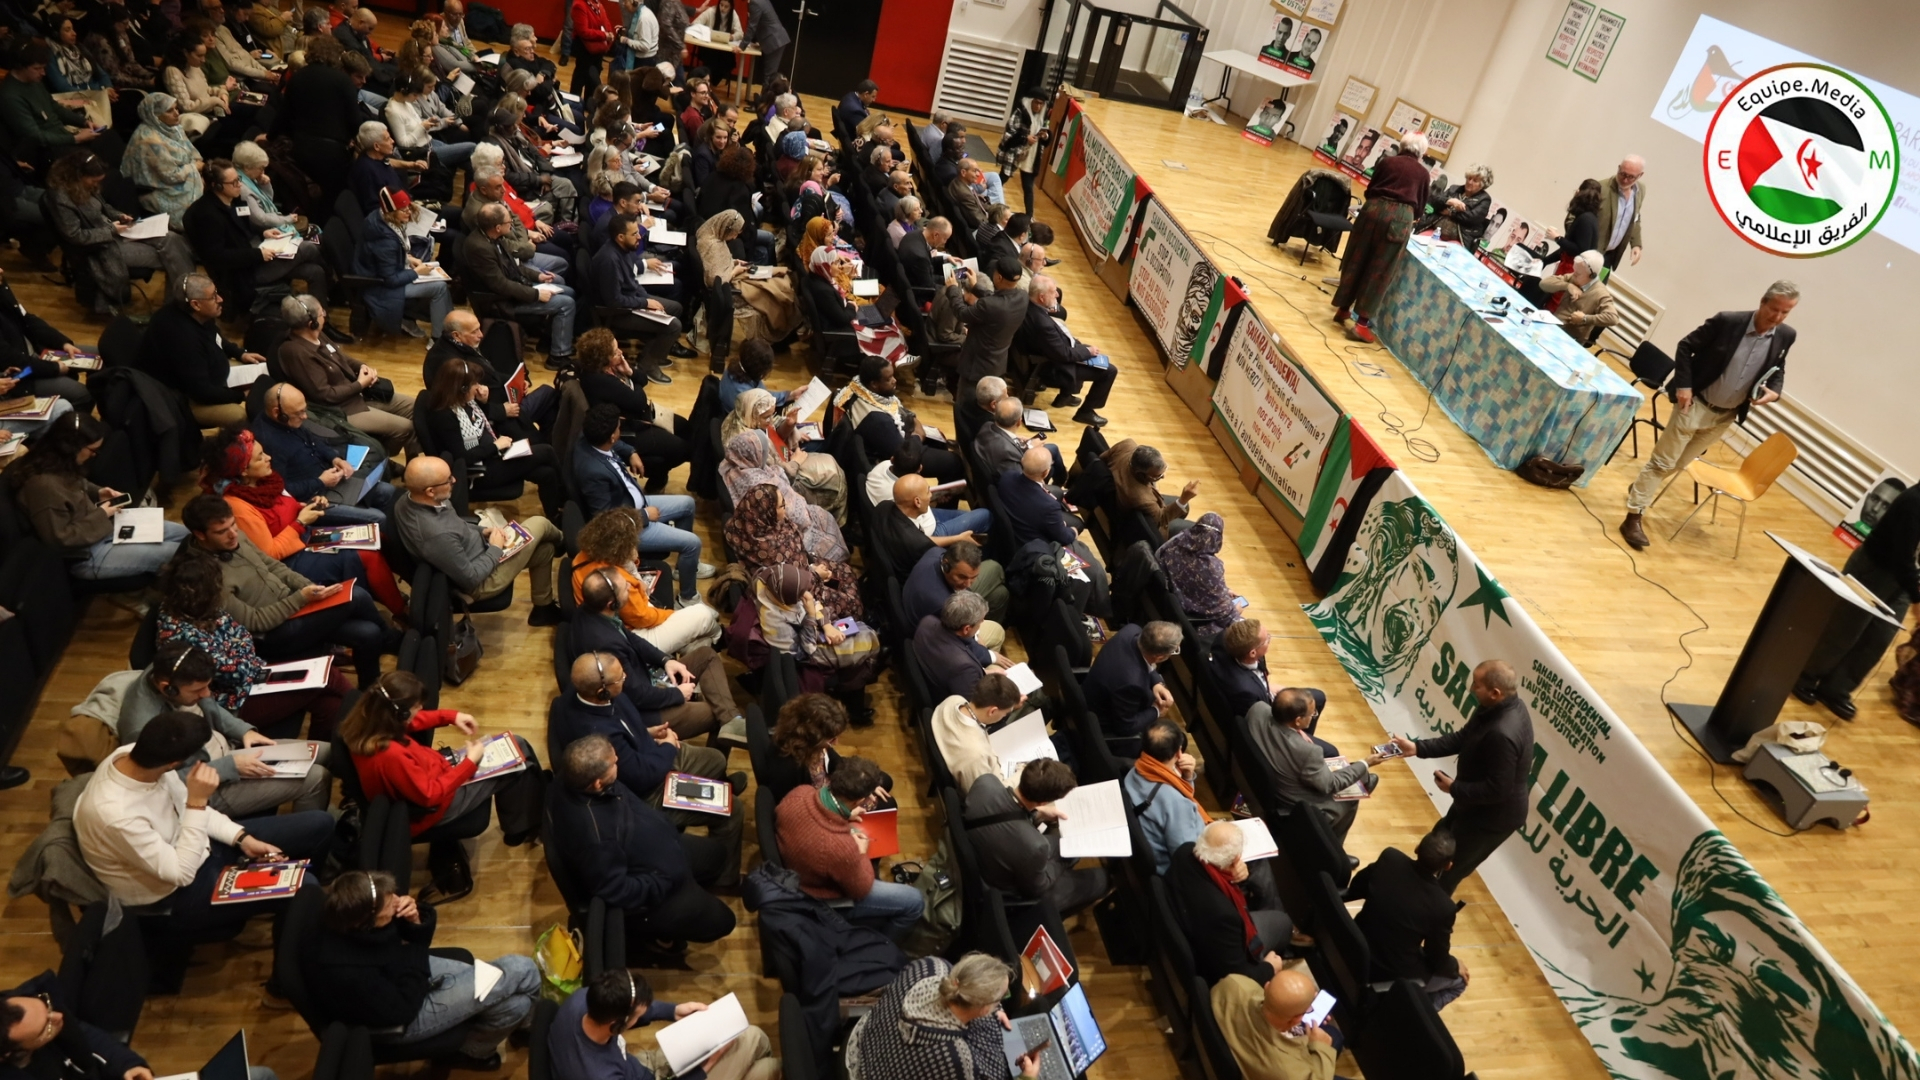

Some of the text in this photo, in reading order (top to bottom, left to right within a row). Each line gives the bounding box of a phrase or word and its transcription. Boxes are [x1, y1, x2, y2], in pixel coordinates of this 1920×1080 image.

[1429, 129, 1449, 141] LIBRE
[1431, 118, 1454, 134] SAHARA
[1151, 212, 1190, 267] SAHARA OCCIDENTAL
[1158, 243, 1169, 262] STOP
[1136, 281, 1146, 298] NOS
[1138, 265, 1150, 283] STOP
[1148, 277, 1155, 292] AU
[1236, 352, 1246, 369] NON
[1244, 364, 1261, 388] MERCI
[1246, 320, 1300, 395] SAHARA OCCIDENTAL
[1264, 370, 1285, 402] marocain
[1265, 390, 1278, 412] Notre
[1222, 396, 1234, 422] Place
[1256, 406, 1268, 422] nos
[1260, 433, 1273, 449] voix
[1532, 659, 1563, 689] SAHARA
[1521, 675, 1606, 764] L'AUTODETERMINATION
[1536, 675, 1598, 739] UNE LUTTE POUR
[1531, 697, 1539, 710] &
[1540, 704, 1550, 719] LA
[1549, 715, 1580, 749] JUSTICE
[1536, 768, 1661, 912] LIBRE
[1549, 848, 1630, 950] الحرية
